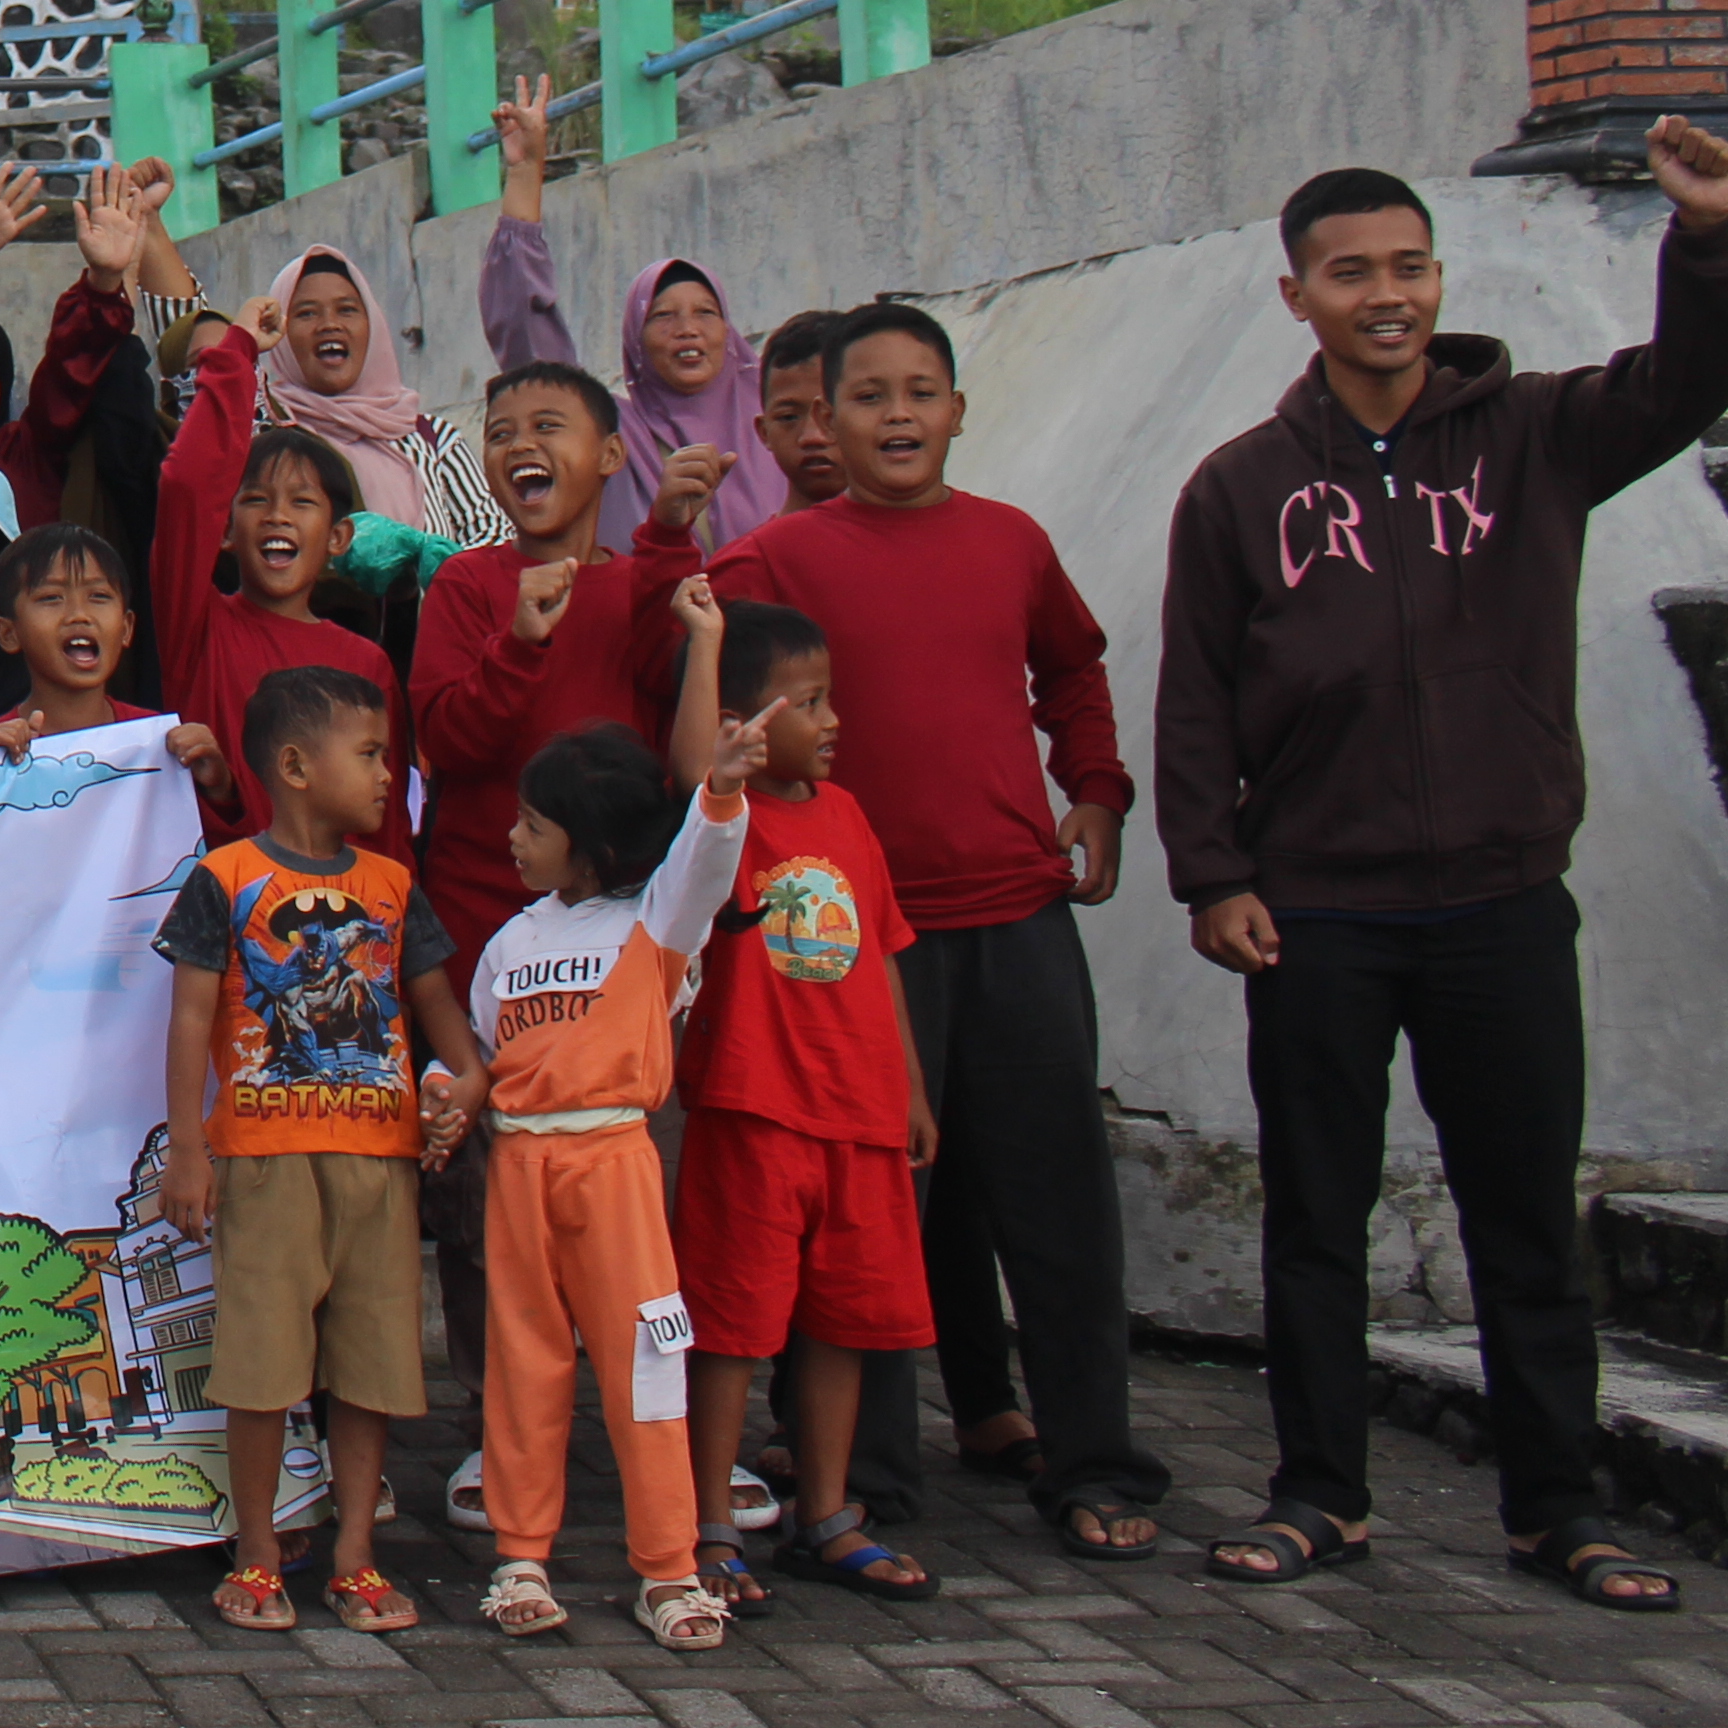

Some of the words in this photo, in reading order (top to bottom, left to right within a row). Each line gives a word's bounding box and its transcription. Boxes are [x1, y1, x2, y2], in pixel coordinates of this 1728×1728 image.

[506, 956, 601, 995] TOUCH!
[785, 958, 843, 981] Beach
[234, 1084, 402, 1123] BATMAN
